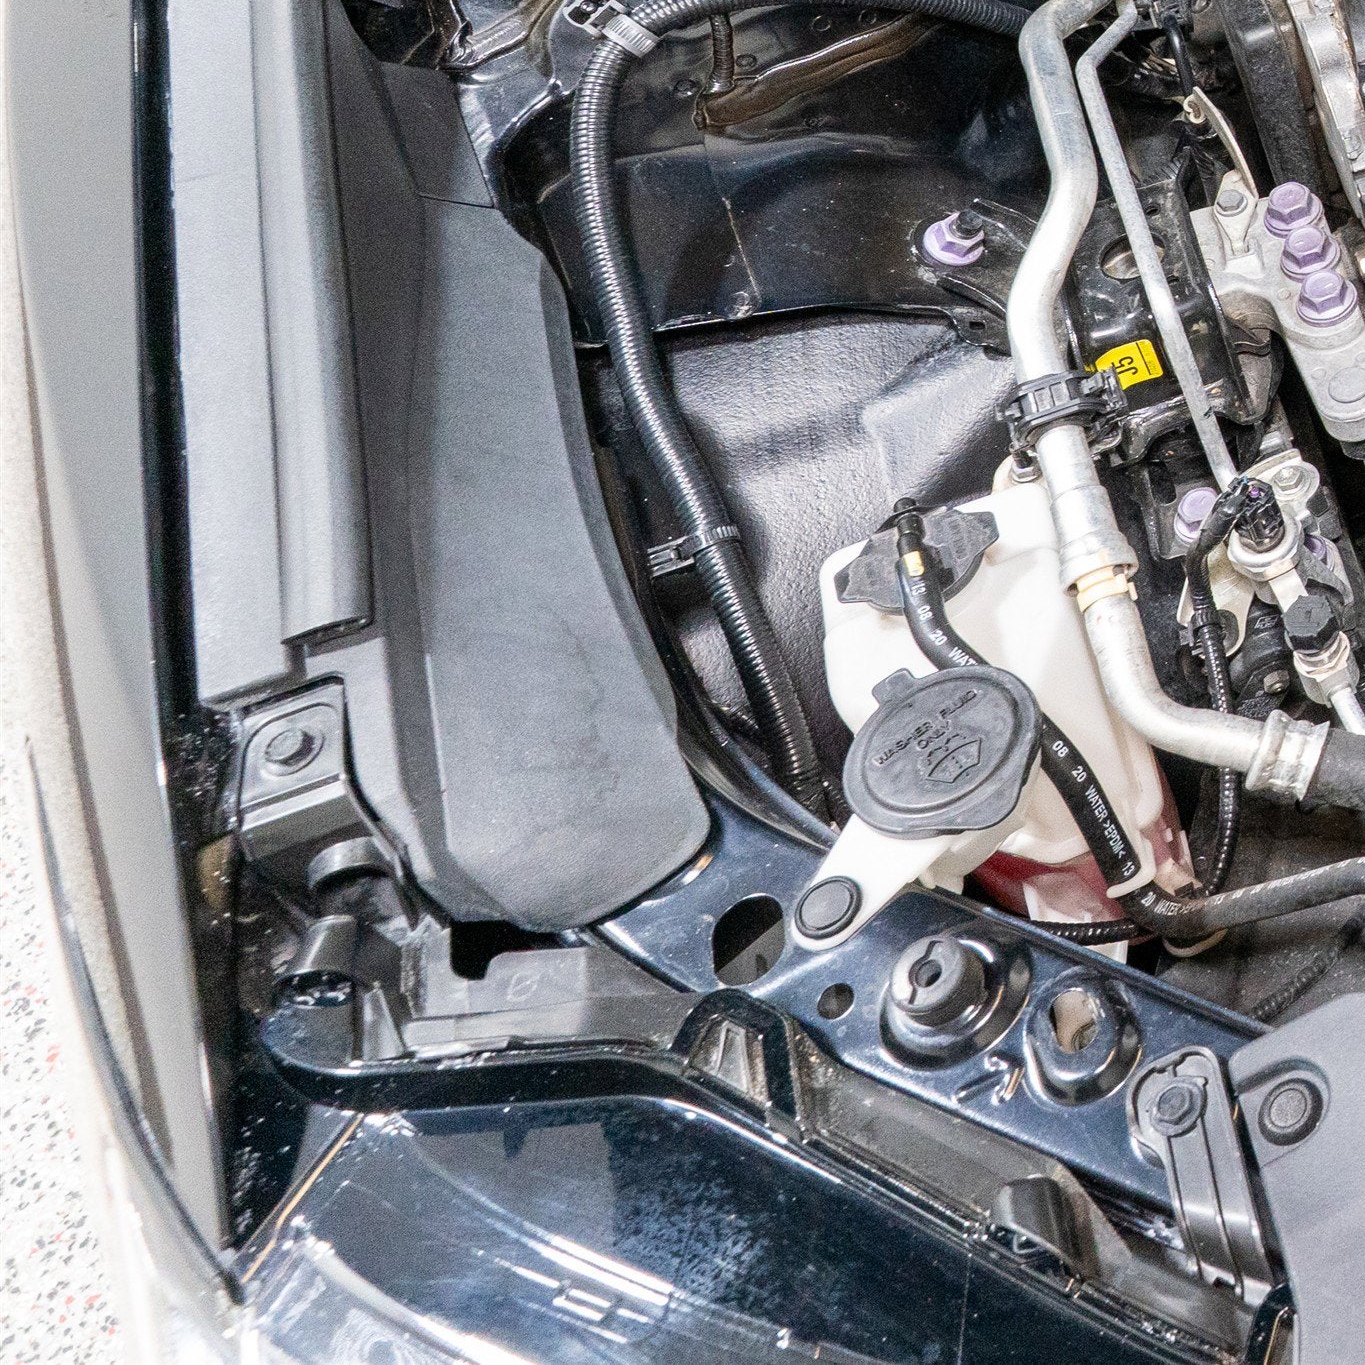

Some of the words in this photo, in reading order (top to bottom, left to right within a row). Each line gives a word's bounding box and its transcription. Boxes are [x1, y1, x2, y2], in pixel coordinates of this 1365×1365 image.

[918, 605, 934, 621] 08
[931, 629, 947, 645] 20
[948, 646, 978, 666] WAT
[875, 721, 933, 765] WASHER
[940, 690, 977, 720] FLUID
[917, 720, 952, 750] ONLY
[1052, 740, 1069, 758] 08
[1072, 765, 1087, 782] 20
[1085, 784, 1109, 822] WATER
[1102, 819, 1126, 859] >EPDM<
[1122, 861, 1136, 877] 13
[1141, 891, 1155, 907] 20
[1154, 900, 1181, 916] WATER
